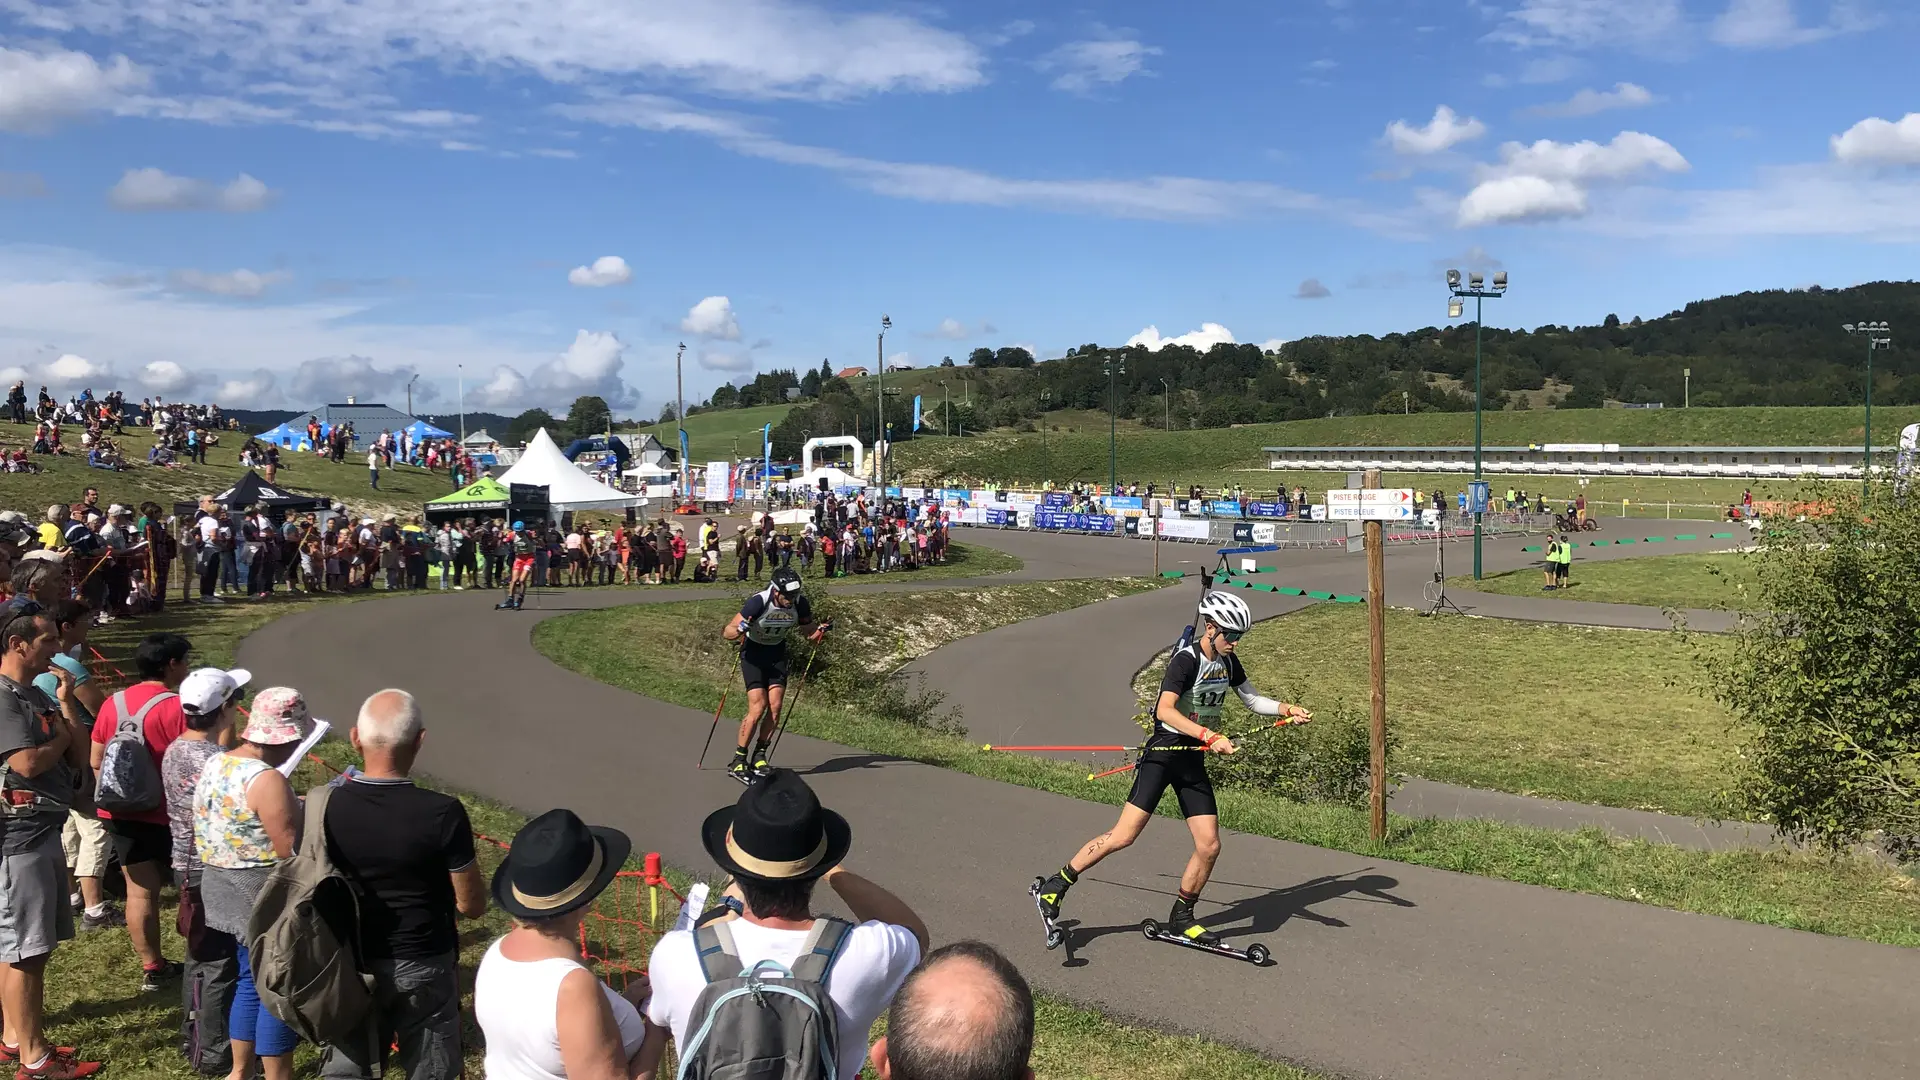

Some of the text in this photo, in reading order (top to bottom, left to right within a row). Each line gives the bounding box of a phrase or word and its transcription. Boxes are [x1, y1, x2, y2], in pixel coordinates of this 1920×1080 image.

[1333, 493, 1377, 501] PISTE ROUGE
[1334, 508, 1375, 516] PISTE BLEUE
[1087, 832, 1113, 856] 124
